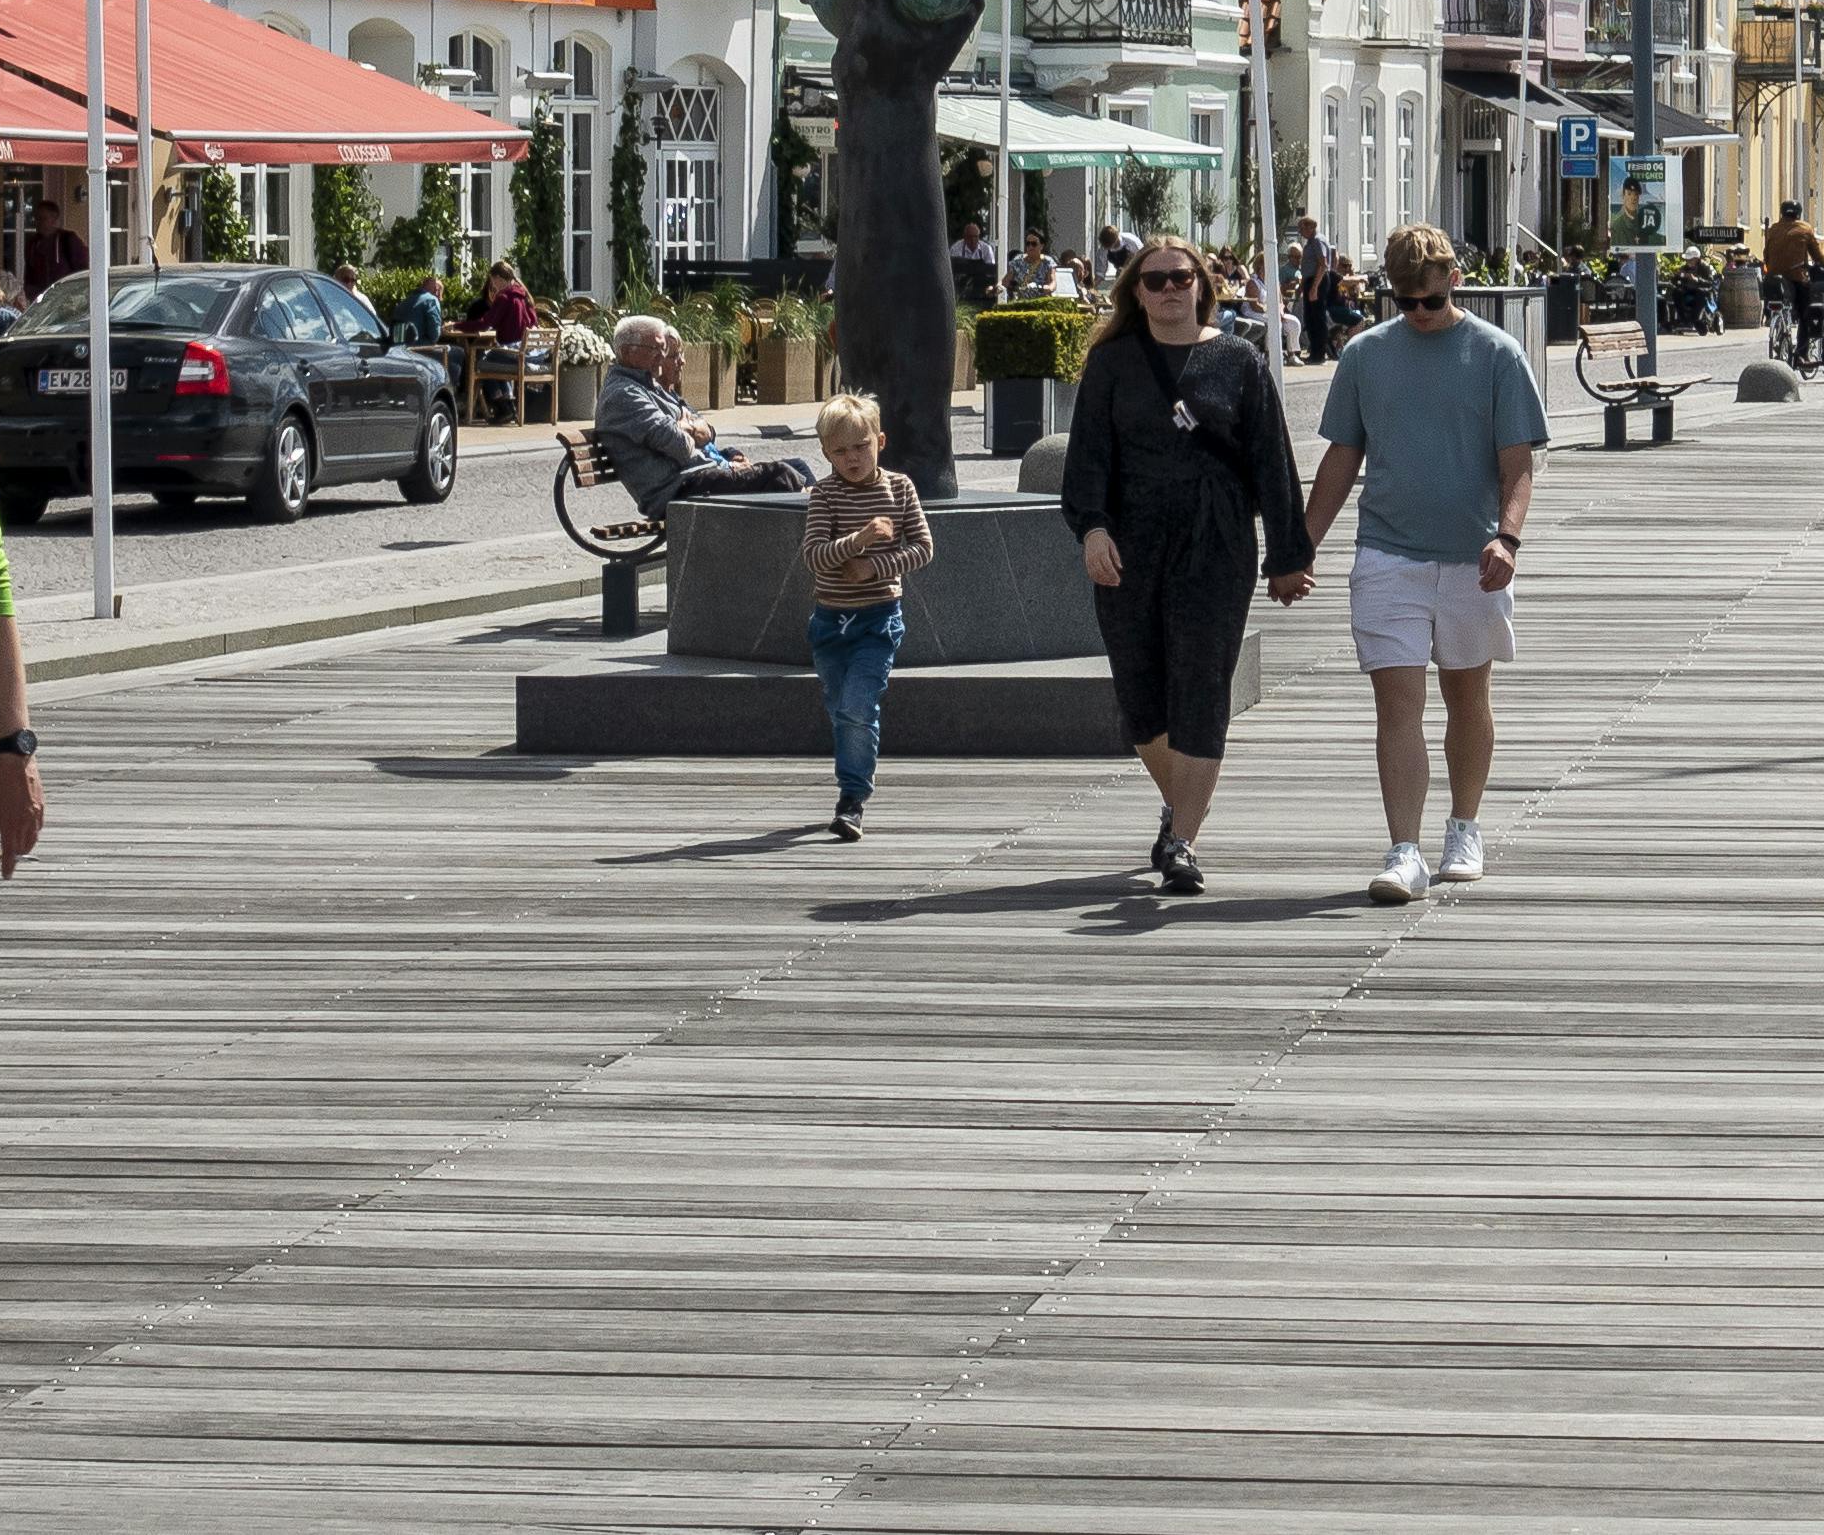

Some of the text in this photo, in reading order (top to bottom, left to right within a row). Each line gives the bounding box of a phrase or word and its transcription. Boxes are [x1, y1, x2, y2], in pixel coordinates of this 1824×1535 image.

[1570, 123, 1590, 152] P
[337, 144, 393, 162] COLOSSEUM
[1641, 214, 1656, 228] JA
